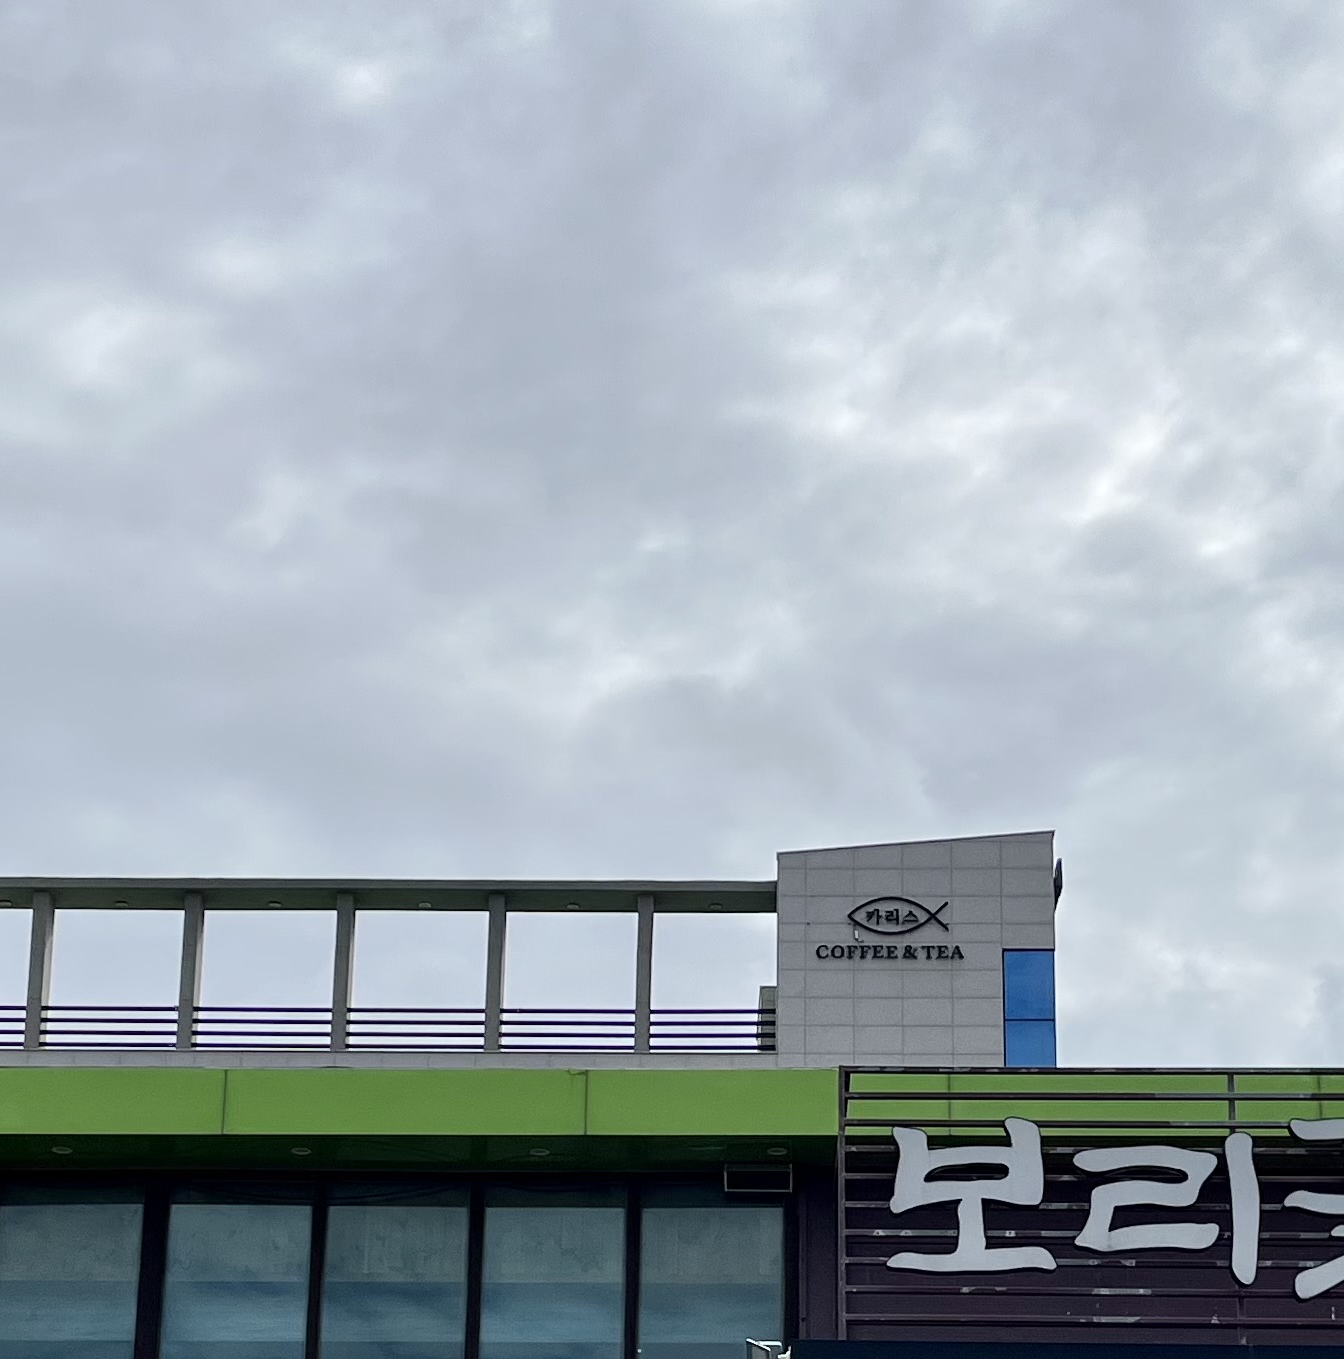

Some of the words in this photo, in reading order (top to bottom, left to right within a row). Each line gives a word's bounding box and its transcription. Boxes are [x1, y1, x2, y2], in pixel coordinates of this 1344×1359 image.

[865, 908, 919, 926] 카리스
[815, 944, 899, 960] COFFEE
[902, 944, 918, 960] &
[921, 945, 965, 960] TEA
